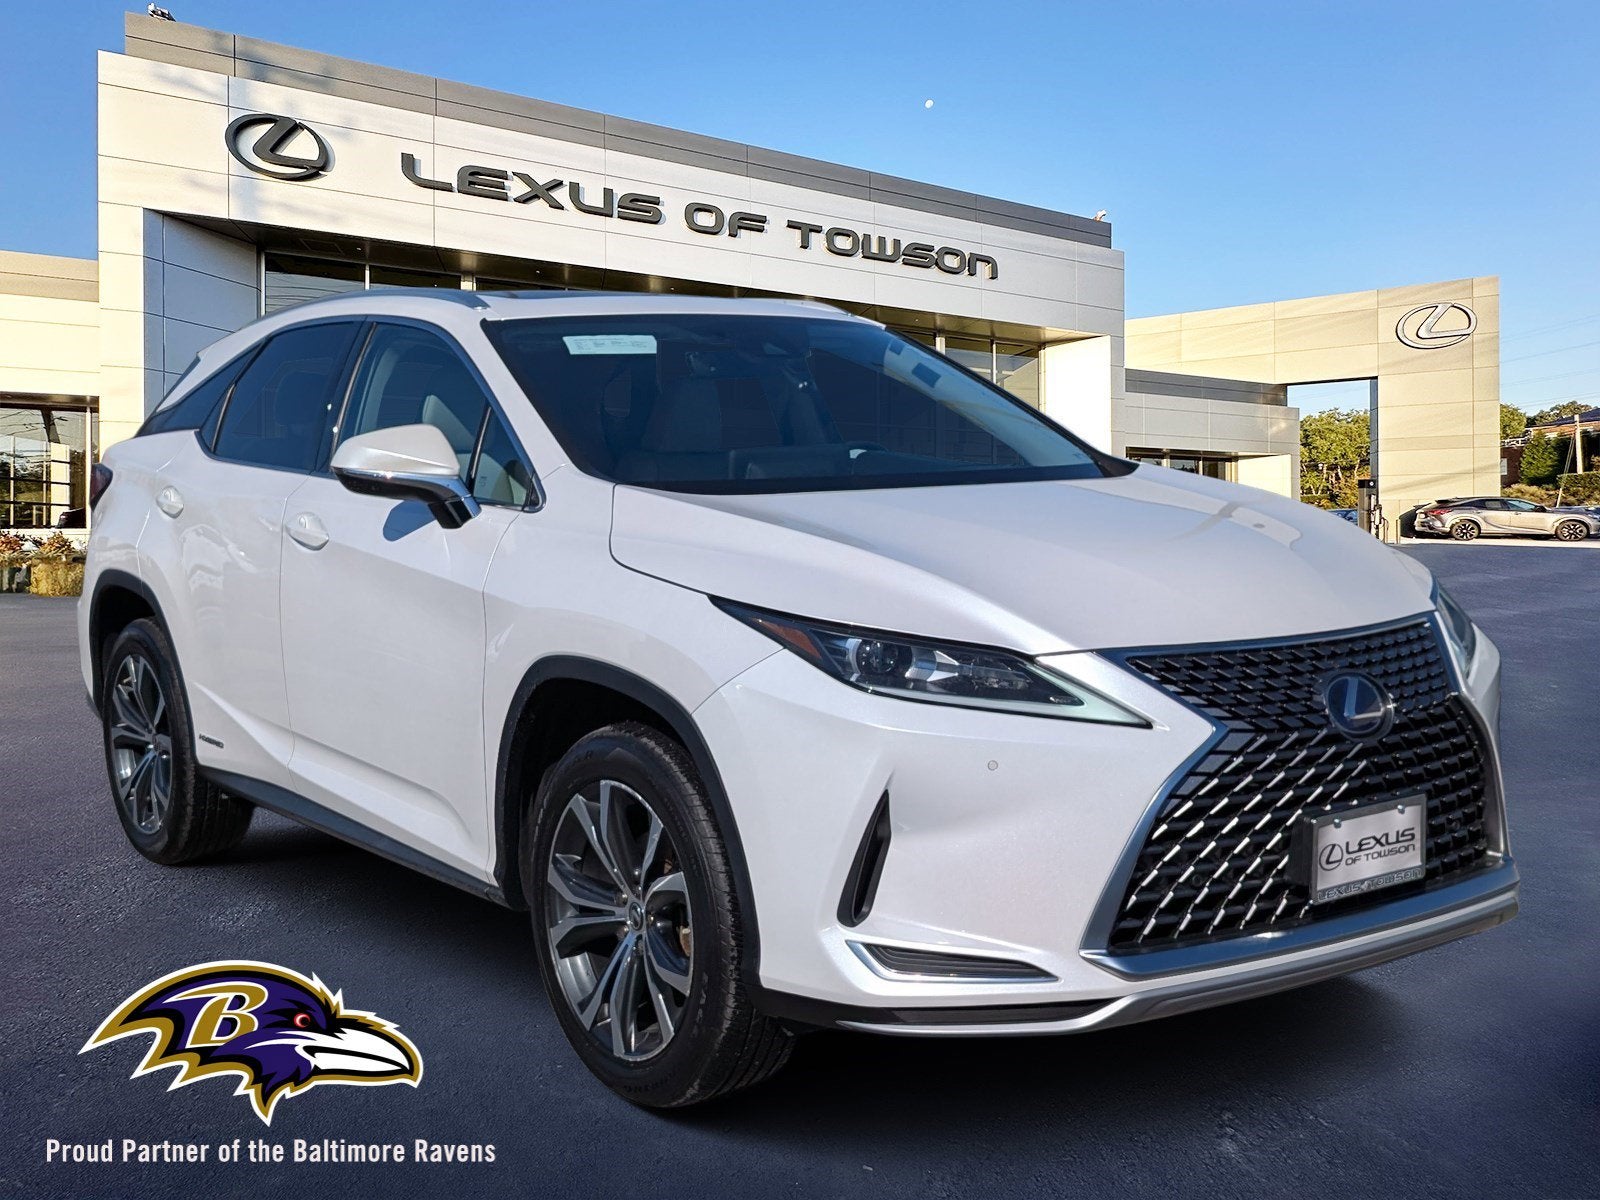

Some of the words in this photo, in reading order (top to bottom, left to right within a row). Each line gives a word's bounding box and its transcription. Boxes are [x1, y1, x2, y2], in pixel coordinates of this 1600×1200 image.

[400, 152, 663, 225] LEXUS
[684, 201, 768, 237] OF
[787, 219, 998, 280] TOWSON
[1345, 827, 1416, 855] LEXUS
[1345, 854, 1362, 867] OF
[1364, 843, 1416, 861] TOWSON
